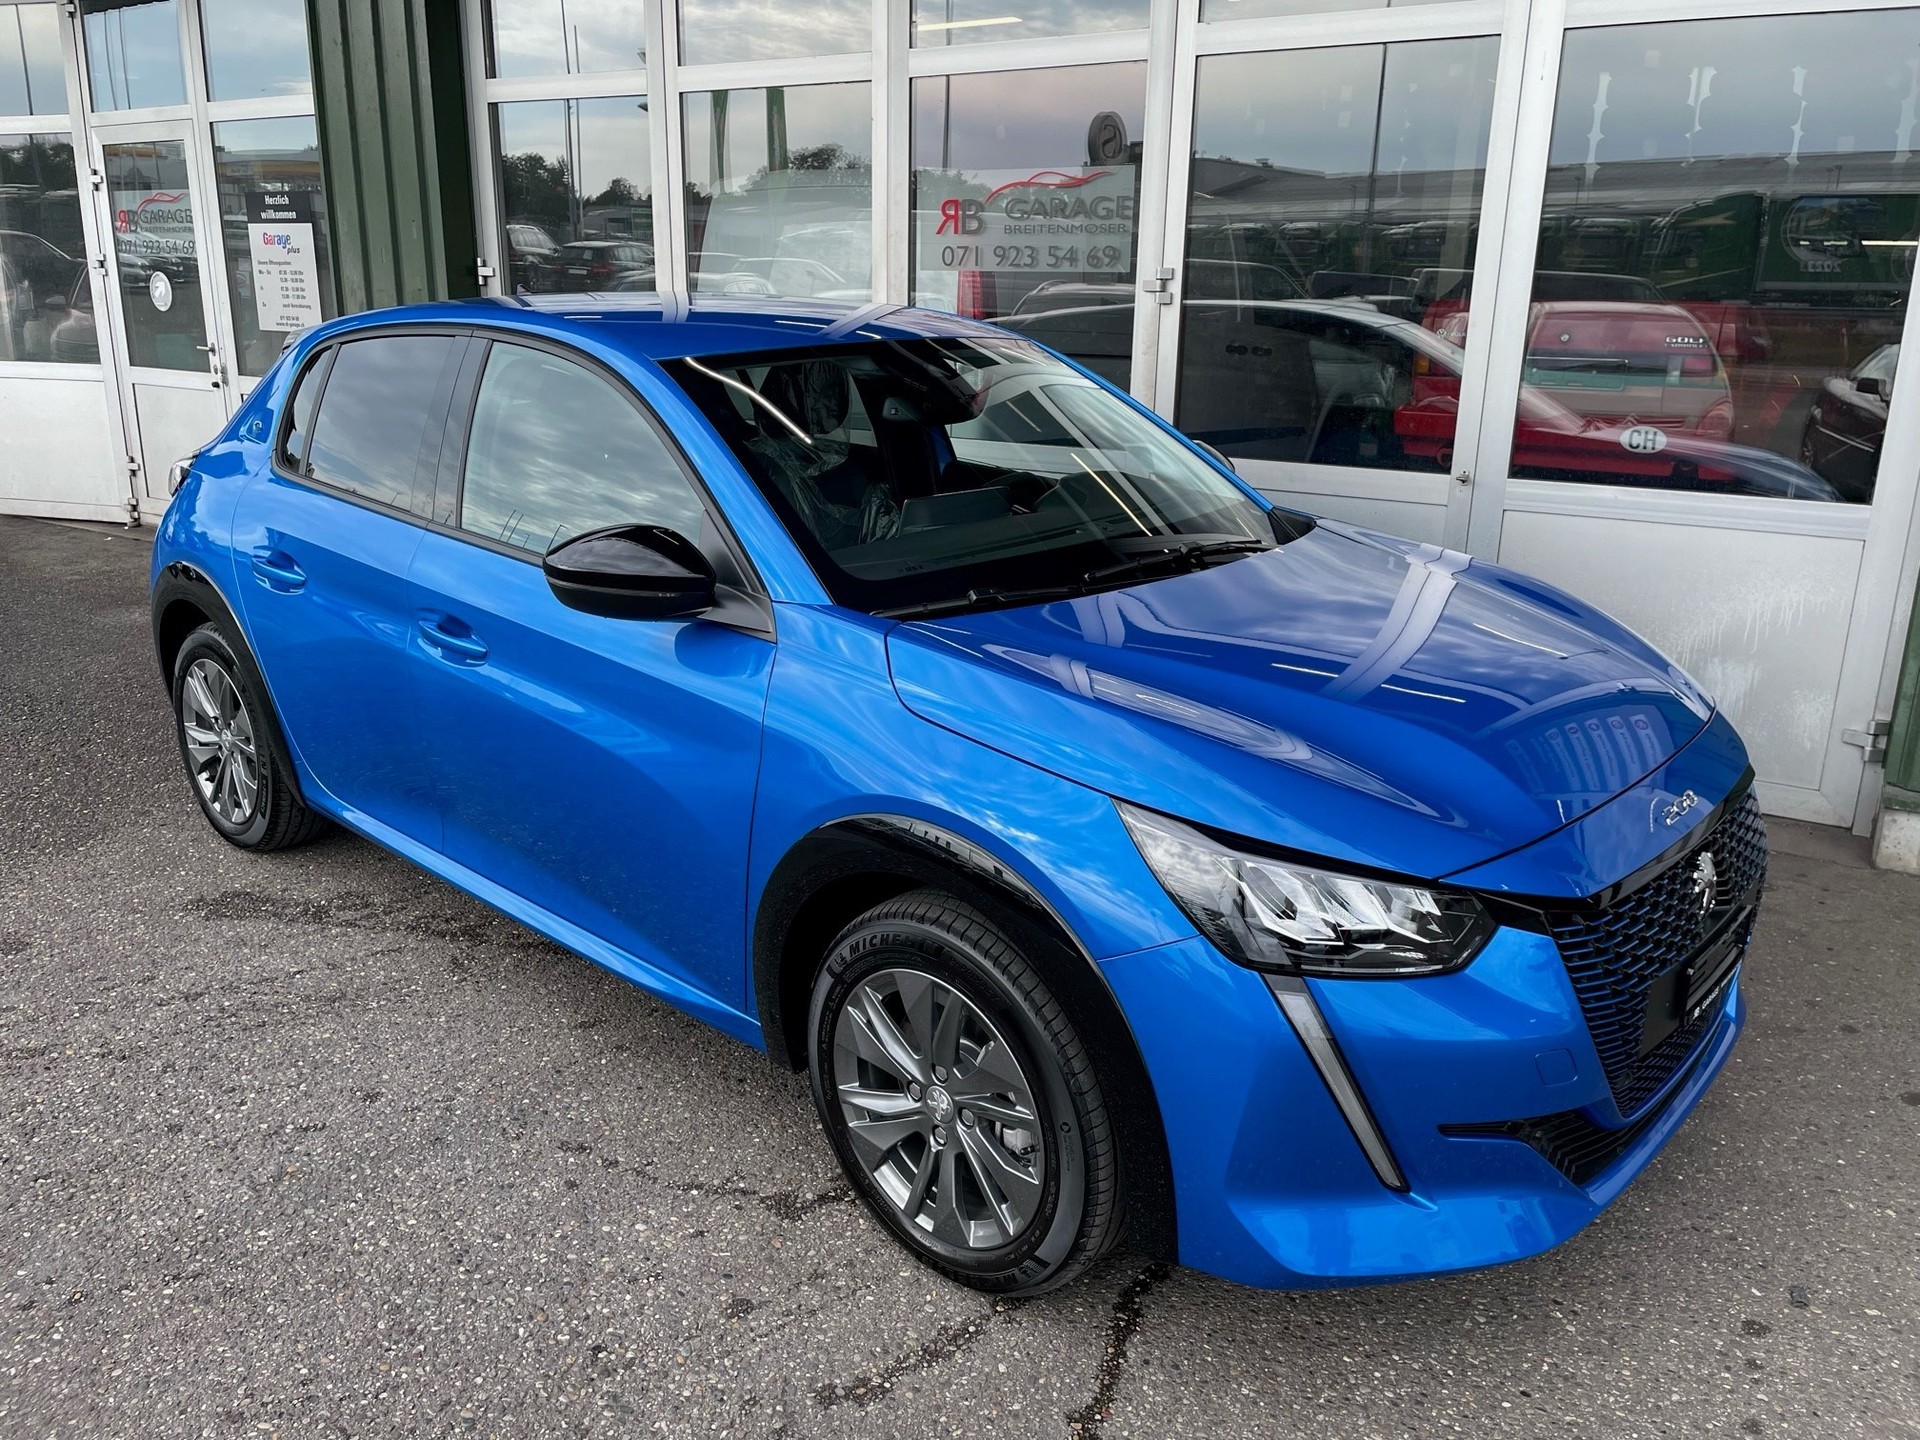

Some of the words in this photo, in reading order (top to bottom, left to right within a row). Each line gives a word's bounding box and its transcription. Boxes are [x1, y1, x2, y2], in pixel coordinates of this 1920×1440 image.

[264, 195, 289, 205] Herzlich
[1004, 196, 1133, 220] GARAGE
[140, 208, 193, 224] GARAGE
[261, 210, 296, 219] willkommen
[1004, 223, 1128, 235] BREITENMOSER
[121, 241, 138, 254] 071
[142, 241, 160, 254] 923
[165, 240, 178, 254] 54
[182, 241, 195, 254] 69
[263, 232, 291, 249] Garage
[287, 246, 300, 255] plus
[941, 246, 979, 266] 071
[993, 246, 1036, 267] 923
[1046, 246, 1076, 267] 54
[1086, 246, 1121, 267] 69
[1628, 429, 1657, 450] CH
[1661, 789, 1699, 826] 208
[848, 933, 941, 958] MICHEL
